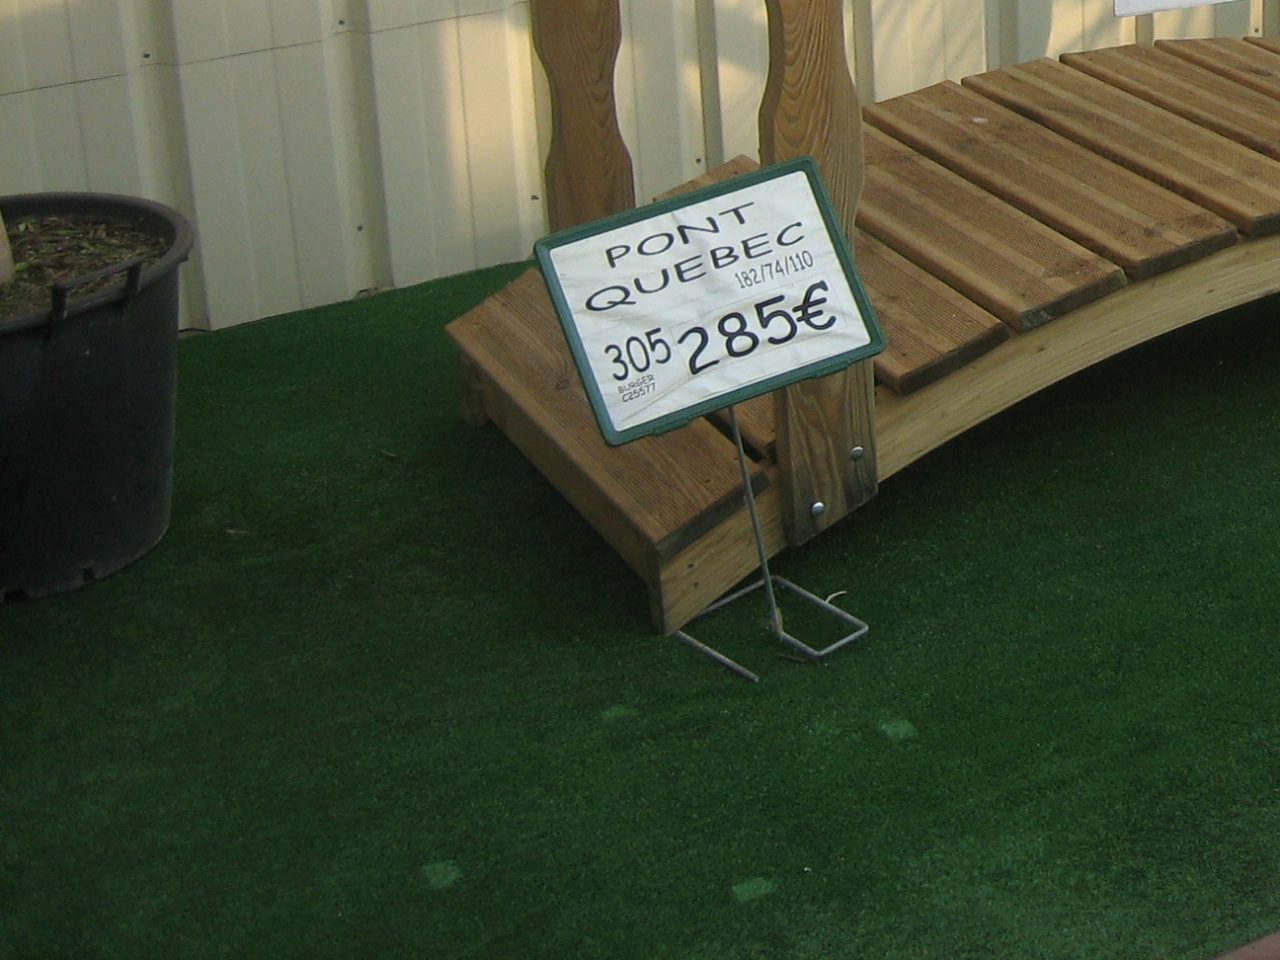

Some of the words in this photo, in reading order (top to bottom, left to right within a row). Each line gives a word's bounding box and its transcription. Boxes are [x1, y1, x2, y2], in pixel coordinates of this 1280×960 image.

[585, 222, 805, 311] QUEBEC
[605, 202, 755, 269] PONT
[735, 250, 814, 289] 182/74/110
[604, 327, 671, 381] 305
[677, 280, 837, 375] 285€
[617, 374, 654, 393] BURGER
